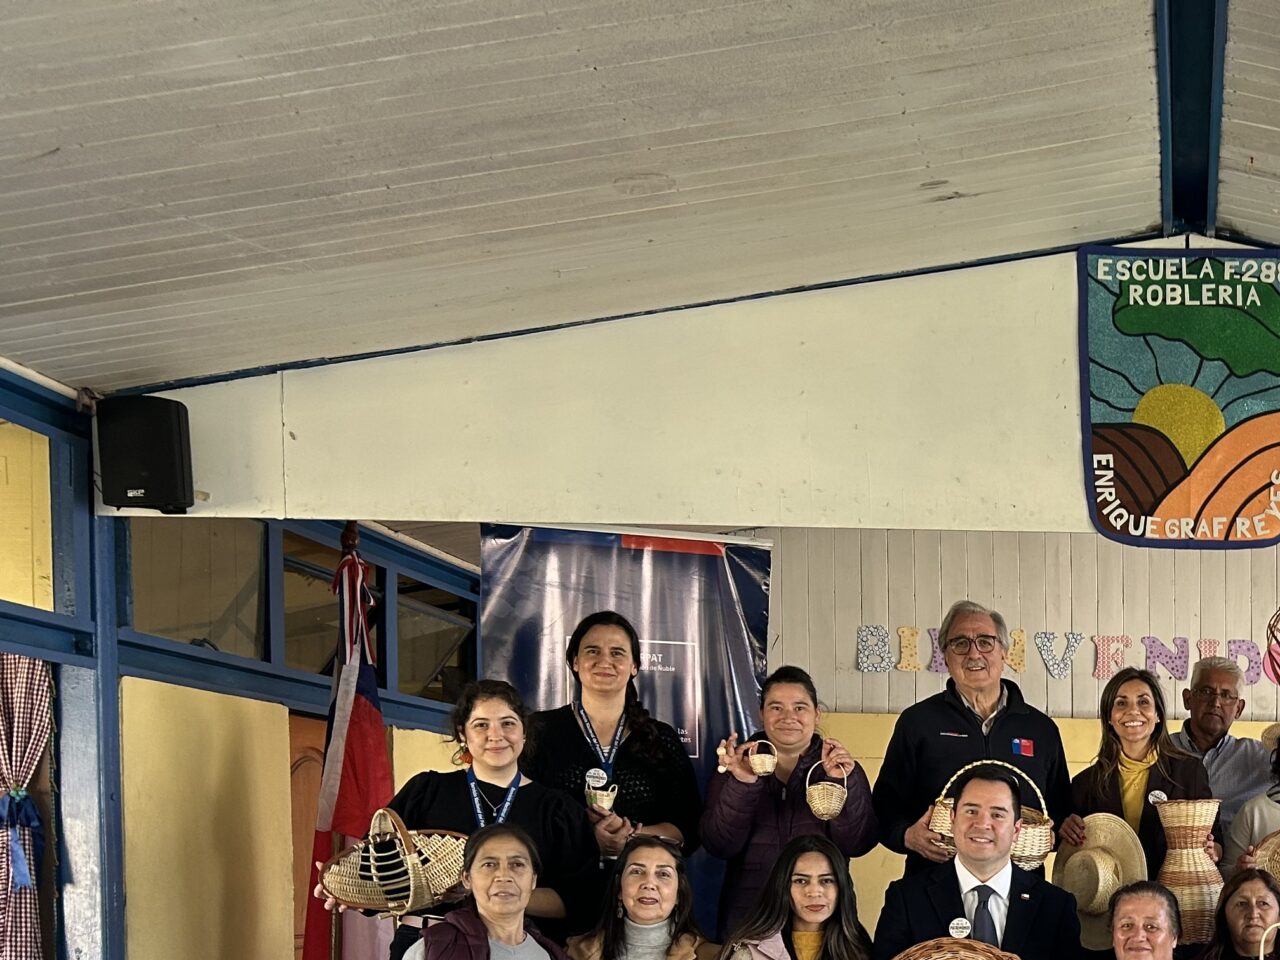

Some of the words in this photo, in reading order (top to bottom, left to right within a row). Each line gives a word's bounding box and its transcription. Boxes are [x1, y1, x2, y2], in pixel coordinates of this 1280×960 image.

[1097, 257, 1215, 281] ESCUELA
[1129, 283, 1261, 307] ROBLERIA
[1093, 454, 1161, 537] ENRIQUE
[1164, 516, 1227, 539] GRAF
